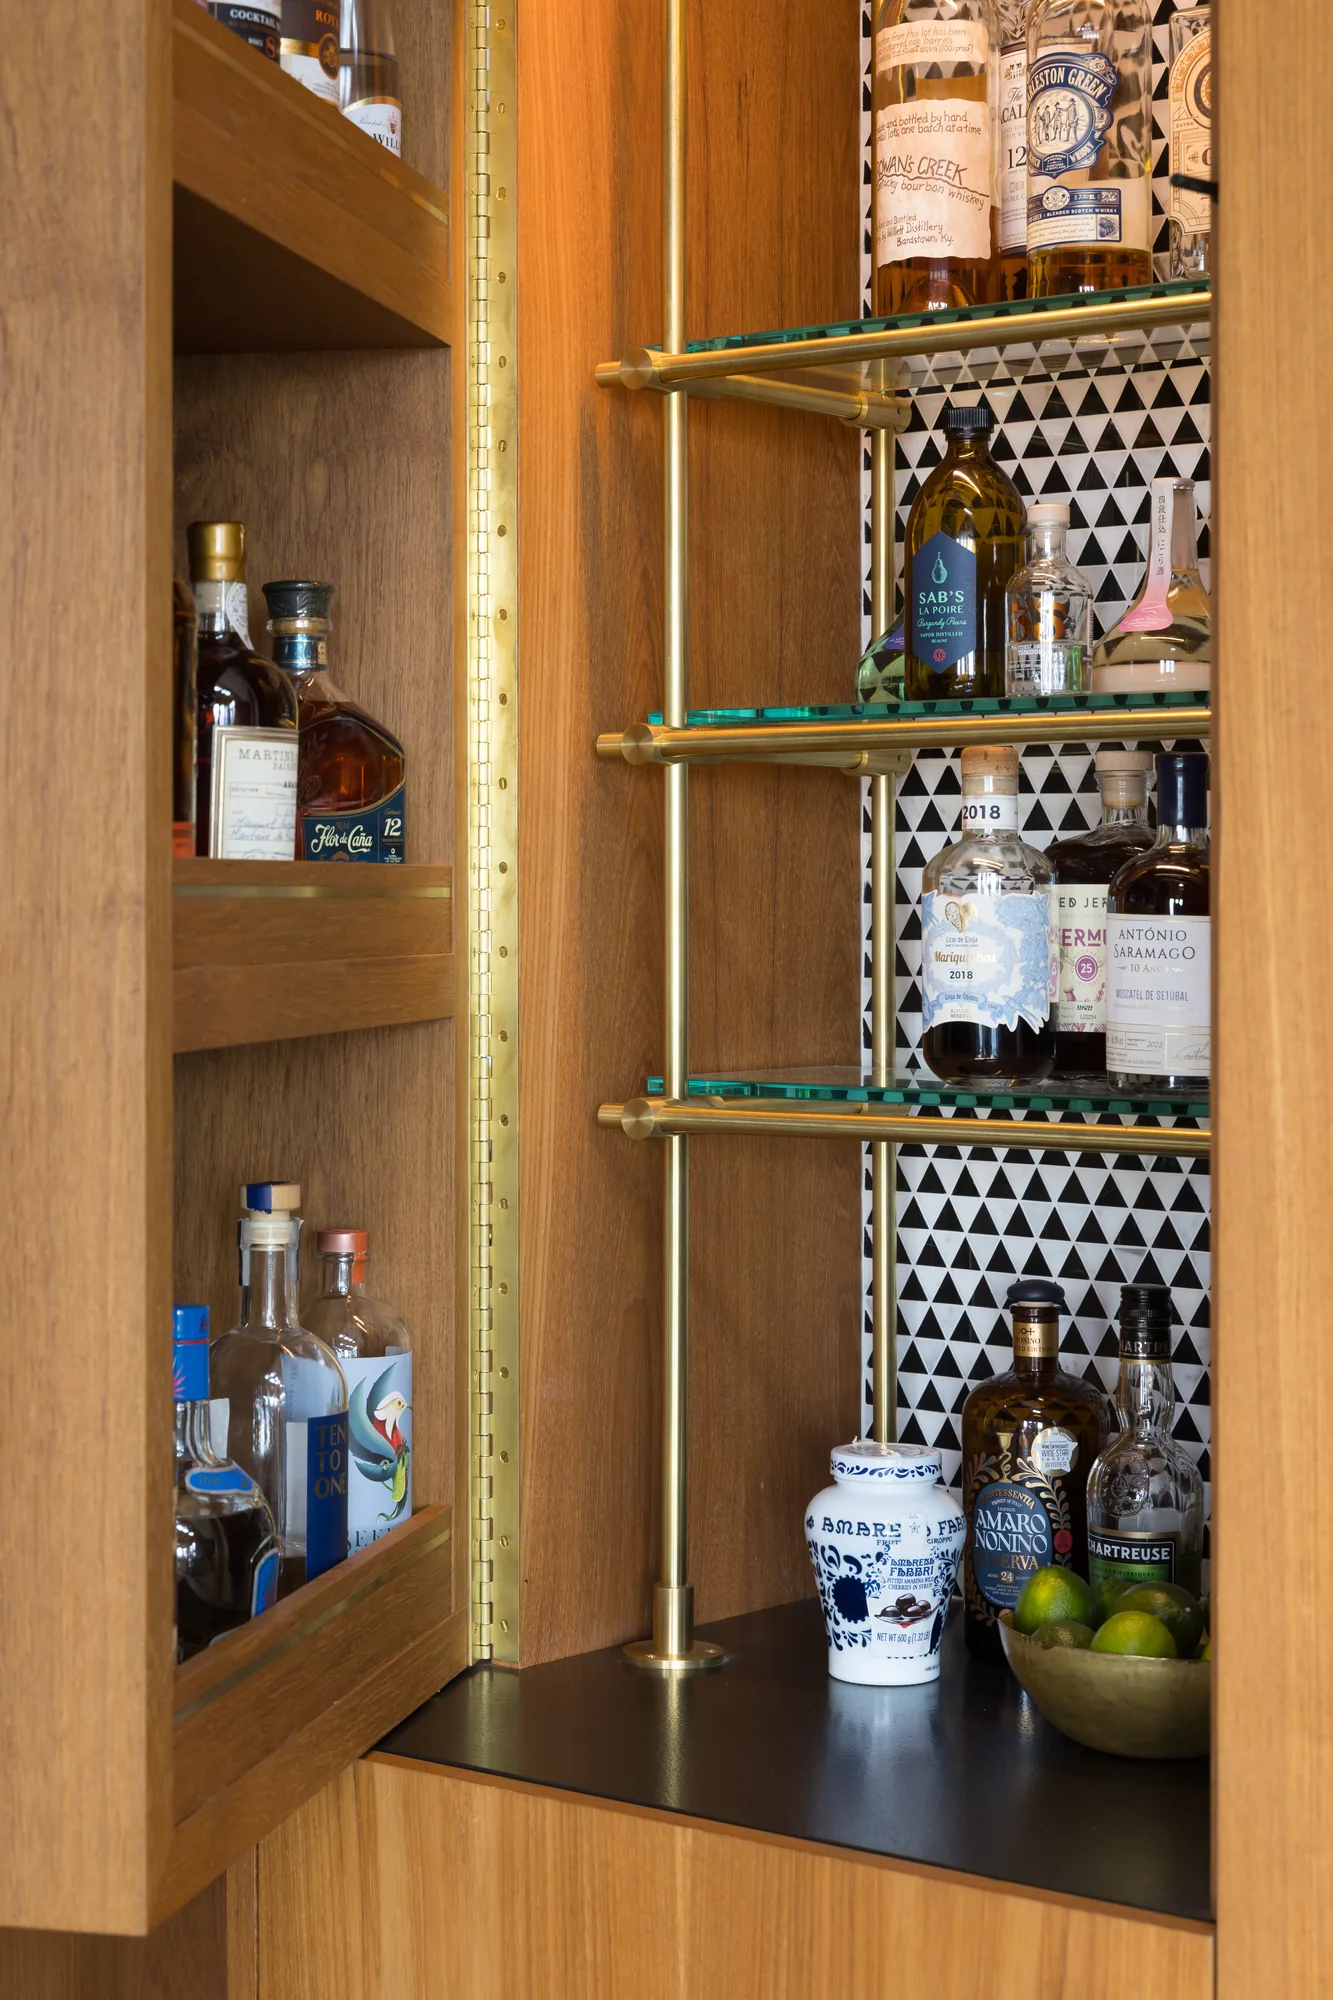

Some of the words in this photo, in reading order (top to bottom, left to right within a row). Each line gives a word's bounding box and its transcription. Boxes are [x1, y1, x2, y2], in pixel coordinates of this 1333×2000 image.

[906, 28, 919, 39] this
[921, 26, 931, 36] lot
[932, 26, 946, 36] has
[948, 26, 966, 36] been
[924, 36, 953, 45] barrels
[1068, 68, 1107, 99] GREEN
[886, 117, 898, 129] and
[899, 112, 929, 126] bottled
[931, 112, 942, 126] by
[944, 110, 967, 122] hand
[901, 125, 915, 135] one
[918, 123, 943, 134] batch
[945, 124, 955, 133] at
[964, 122, 982, 135] time
[1007, 146, 1026, 169] 12
[918, 156, 968, 186] CREEK
[900, 179, 944, 194] bourbon
[948, 188, 984, 211] whiskey
[1046, 207, 1070, 217] BLENDED
[906, 220, 943, 235] Distillery
[896, 235, 938, 247] Bardstown,
[941, 233, 954, 246] Ky.
[919, 590, 965, 605] SAB'S
[919, 606, 930, 616] LA
[932, 605, 964, 615] POIRE
[963, 805, 1001, 819] 2018
[384, 818, 402, 836] 12
[311, 824, 339, 853] Flor
[339, 832, 348, 844] de
[347, 825, 373, 853] Caña
[1118, 926, 1187, 942] ANTÓNIO
[934, 951, 996, 965] Mariquhas
[949, 971, 973, 980] 2018
[1080, 963, 1093, 974] 25
[1130, 963, 1140, 973] 10
[1116, 988, 1143, 1000] MOSCATEL
[1145, 990, 1154, 1001] DE
[1156, 989, 1189, 1002] SETÚBAL
[314, 1423, 347, 1448] TEN
[315, 1449, 341, 1473] TO
[314, 1472, 347, 1499] ONE
[821, 1516, 931, 1538] AMARE
[975, 1508, 1046, 1535] AMARO
[975, 1528, 1048, 1554] NONINO
[1088, 1537, 1170, 1560] CHARTREUSE
[891, 1558, 935, 1567] AMARENA
[890, 1566, 934, 1577] FABBRI
[1000, 1571, 1013, 1582] 24
[877, 1632, 887, 1641] NET
[888, 1632, 896, 1642] WT
[897, 1633, 907, 1643] 600
[911, 1632, 924, 1644] (1.32
